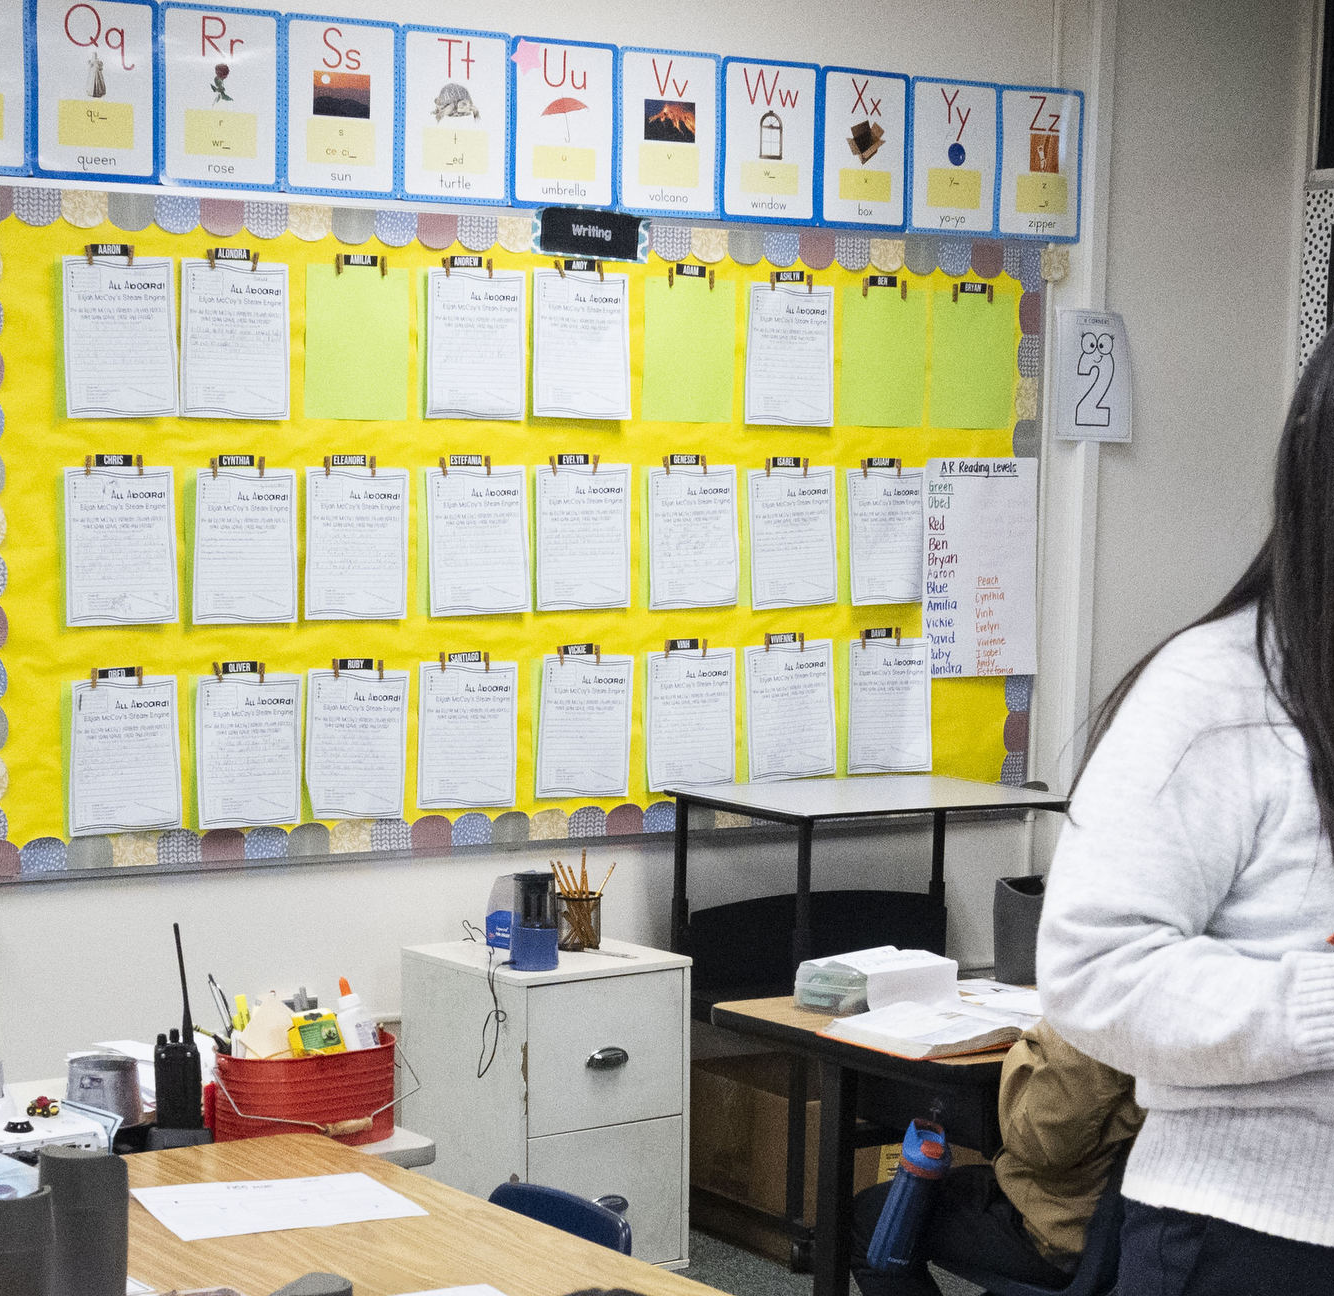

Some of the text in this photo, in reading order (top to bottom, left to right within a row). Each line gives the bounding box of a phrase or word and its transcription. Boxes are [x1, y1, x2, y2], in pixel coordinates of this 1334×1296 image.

[65, 3, 134, 71] Qq
[202, 15, 244, 58] Rr
[322, 27, 362, 71] Ss
[437, 38, 475, 80] Tt
[543, 48, 587, 90] Uu
[652, 58, 688, 98] Vv
[743, 67, 799, 109] Ww
[851, 78, 881, 116] Xx
[940, 87, 971, 141] Yy
[1029, 95, 1060, 132] Zz
[77, 155, 117, 171] queen
[207, 164, 235, 175] rose
[330, 172, 352, 182] sun
[439, 174, 471, 190] turtle
[541, 182, 587, 198] umbrella
[649, 189, 688, 204] volcano
[750, 197, 787, 211] window
[857, 203, 873, 216] box
[939, 213, 966, 226] yo-yo
[1028, 218, 1057, 233] zipper
[571, 223, 612, 241] Writing
[97, 245, 122, 255] AARON
[217, 249, 248, 259] ALONDRA
[349, 255, 372, 266] AMILIA
[453, 256, 479, 267] ANDREW
[572, 260, 588, 271] ANDY
[683, 265, 700, 276] ADAM
[779, 272, 801, 282] ASHLYN
[877, 276, 889, 287] BEN
[964, 283, 982, 293] BRYAN
[103, 455, 124, 466] CHRIS
[222, 455, 251, 466] CYNTHIA
[333, 455, 366, 466] ELEANORE
[450, 455, 482, 466] ESTEFANIA
[562, 455, 585, 465] EVELYN
[673, 454, 697, 465] GENESIS
[776, 457, 795, 467] ISABEL
[958, 461, 989, 478] Reading
[993, 461, 1017, 472] Levels
[928, 480, 953, 492] Green
[928, 496, 951, 509] Obed
[928, 515, 945, 531] Red
[928, 537, 948, 551] Ben
[927, 552, 958, 569] Bryan
[926, 581, 948, 594] Blue
[927, 600, 958, 611] Amilia
[926, 617, 954, 629] Vickie
[449, 652, 480, 662] SANTIAGO
[228, 662, 251, 673] OLIVER
[347, 660, 364, 669] RUBY
